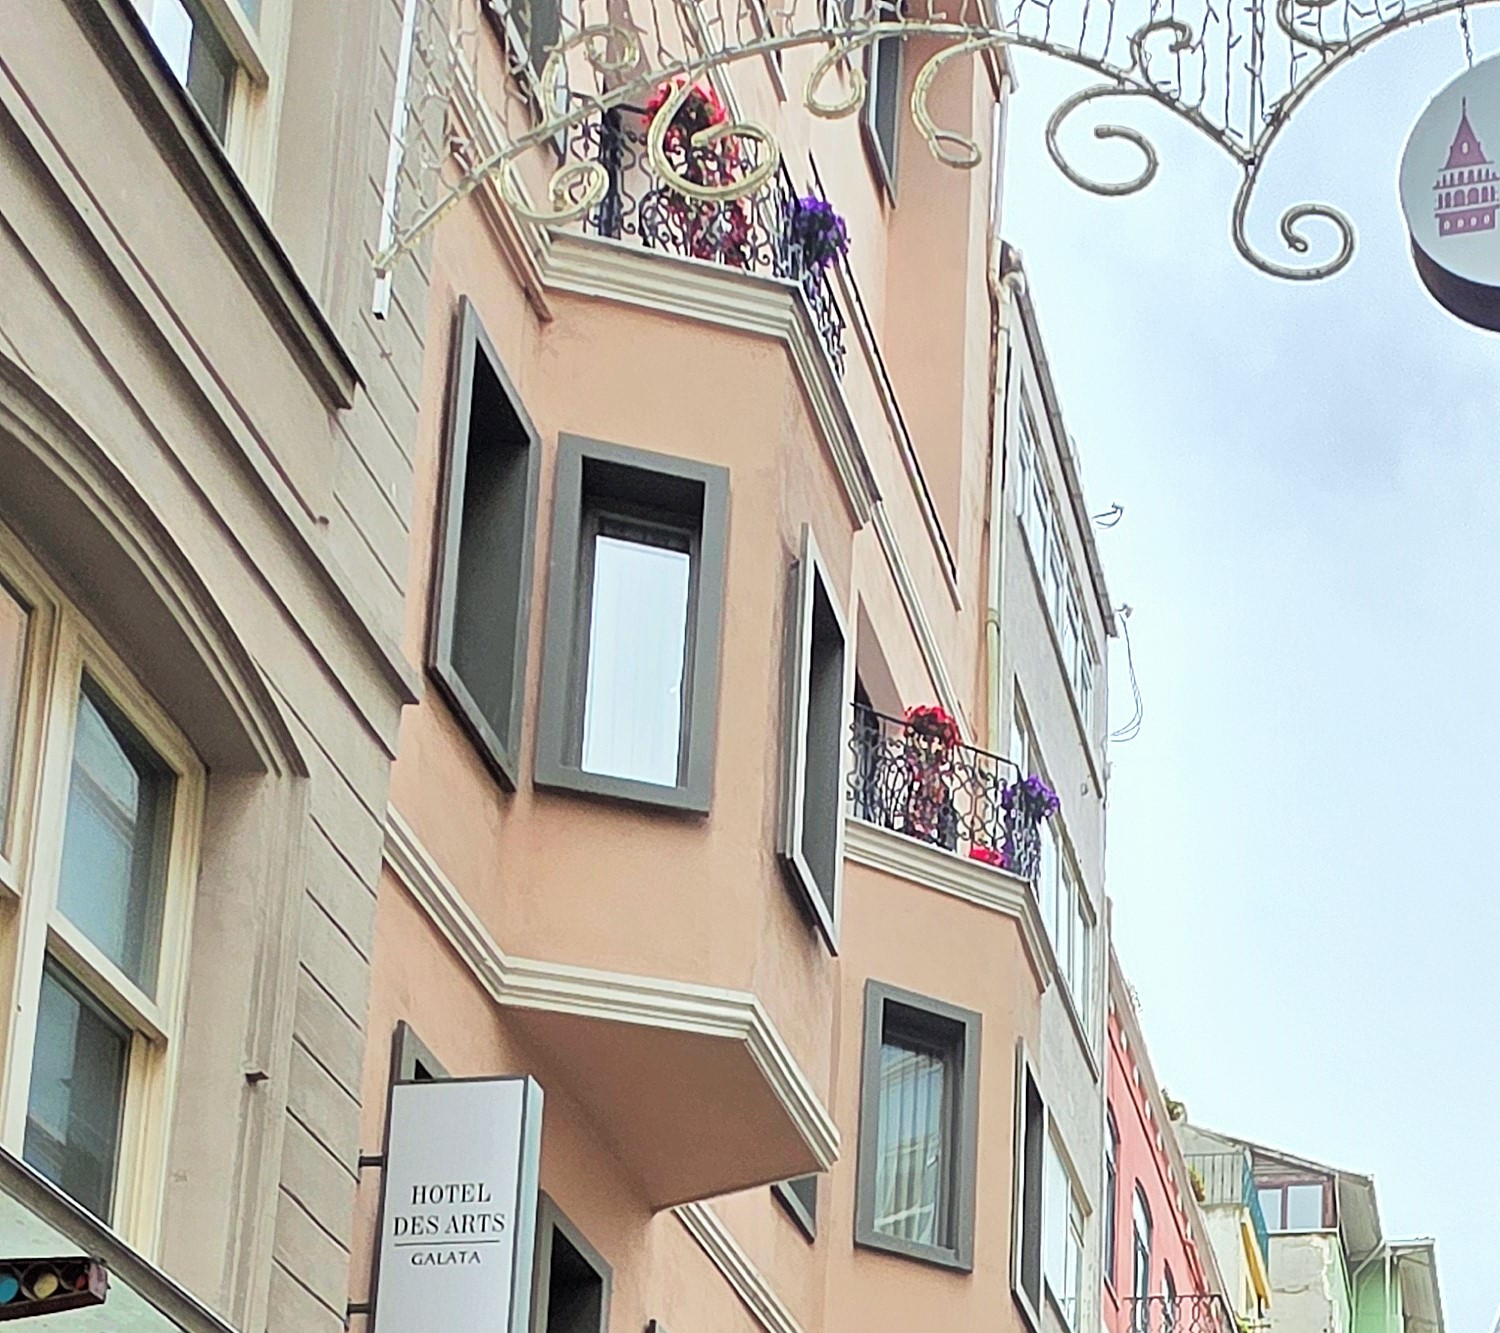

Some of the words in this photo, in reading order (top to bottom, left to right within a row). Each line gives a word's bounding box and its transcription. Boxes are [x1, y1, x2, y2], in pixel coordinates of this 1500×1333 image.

[412, 1183, 492, 1205] HOTEL
[394, 1216, 440, 1237] DES
[444, 1213, 506, 1235] ARTS
[411, 1251, 482, 1266] GALATA
